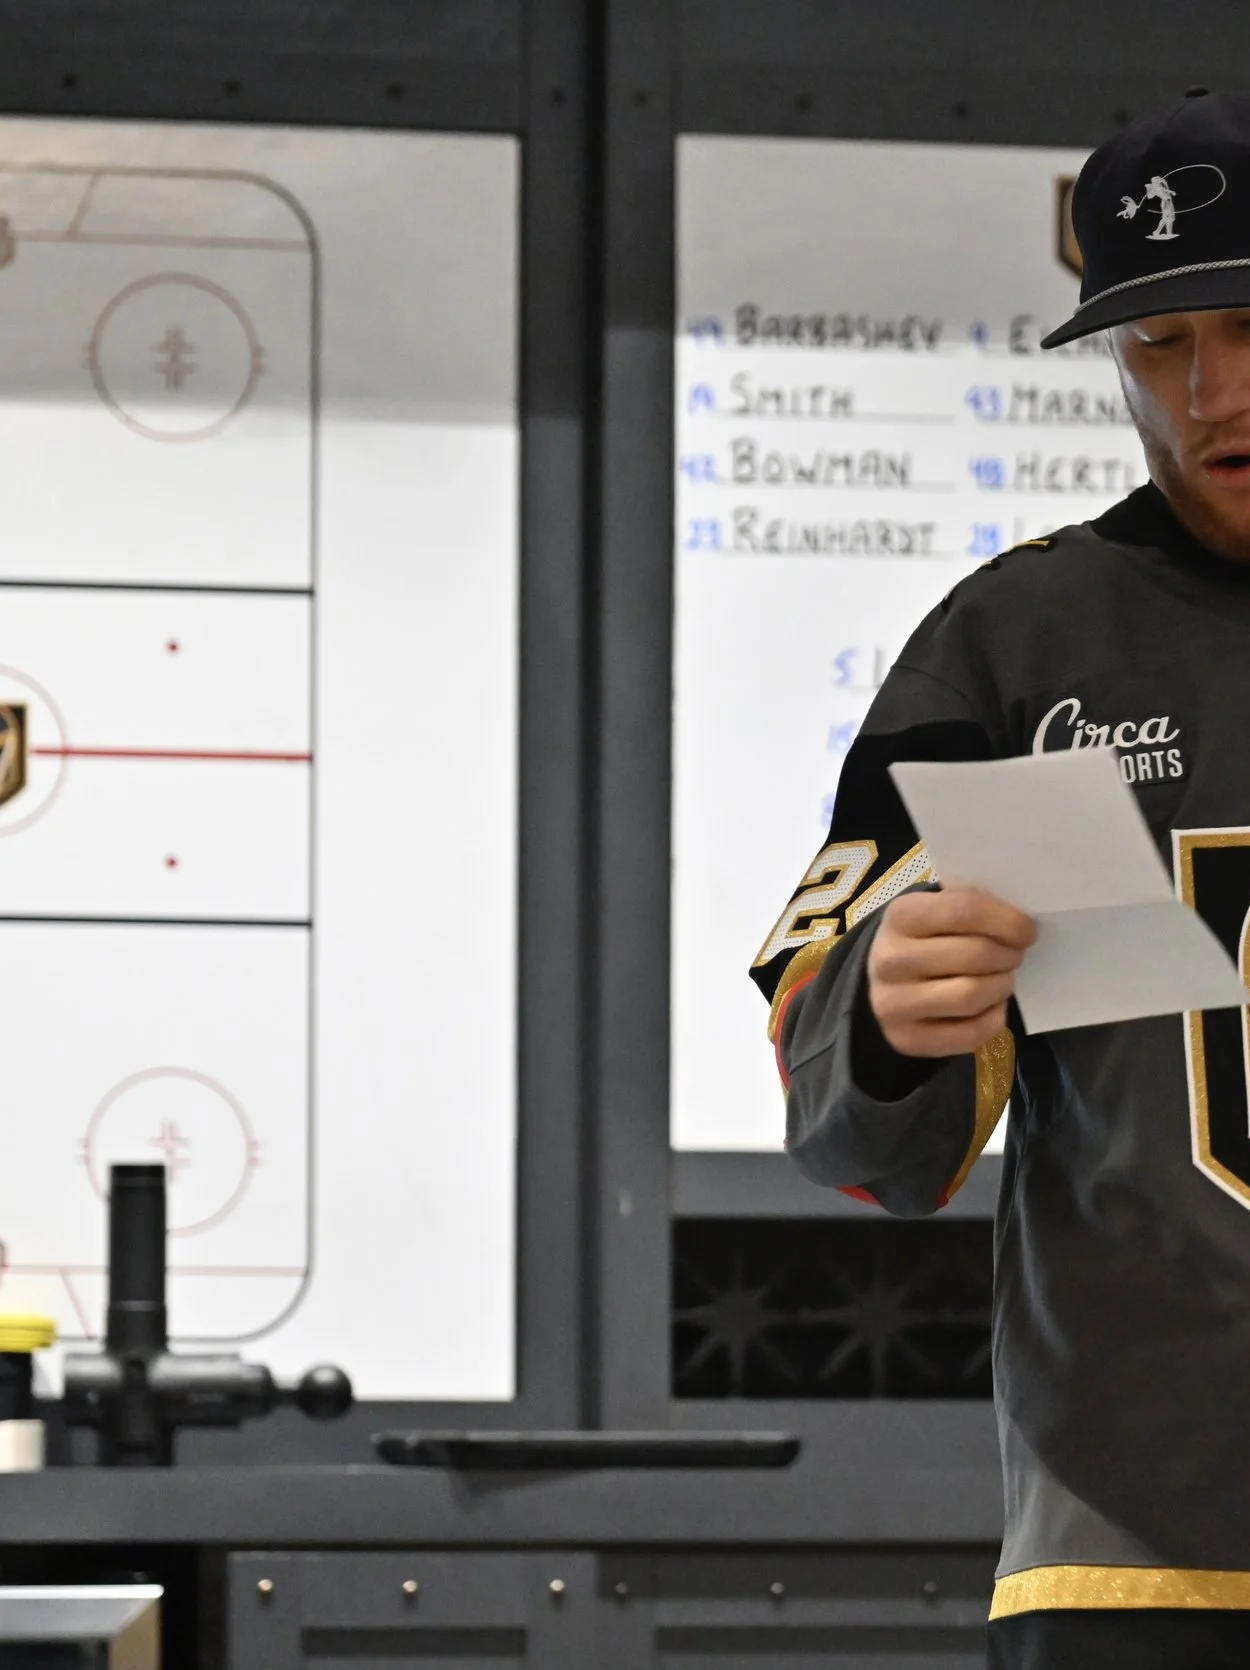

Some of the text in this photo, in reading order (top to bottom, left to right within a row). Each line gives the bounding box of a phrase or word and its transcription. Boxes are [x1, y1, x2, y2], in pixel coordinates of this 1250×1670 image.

[729, 371, 855, 418] SMITH
[1006, 383, 1131, 424] MARN
[730, 437, 914, 487] BOWMAN
[731, 506, 940, 556] REINHARDT
[1032, 698, 1180, 758] Circa
[1119, 748, 1184, 784] ORTS
